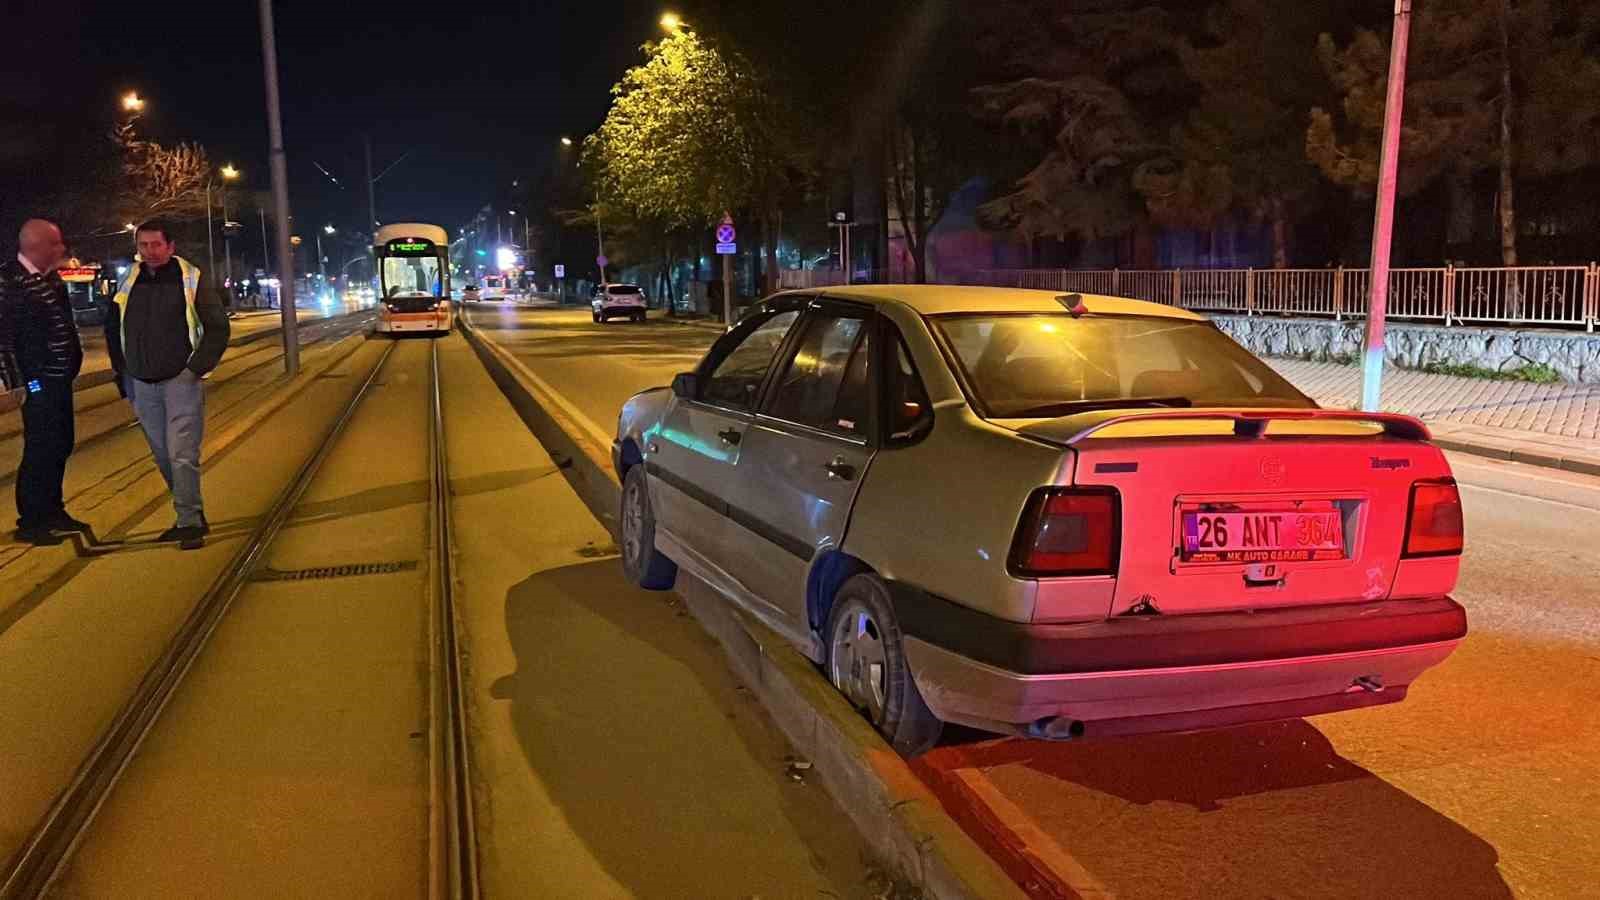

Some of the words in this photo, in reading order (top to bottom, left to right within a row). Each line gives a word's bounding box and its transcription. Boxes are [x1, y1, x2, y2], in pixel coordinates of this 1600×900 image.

[1199, 517, 1228, 548] 26
[1242, 516, 1282, 547] ANT
[1296, 515, 1338, 546] 364
[1226, 551, 1242, 561] MK
[1243, 551, 1269, 561] AUTO
